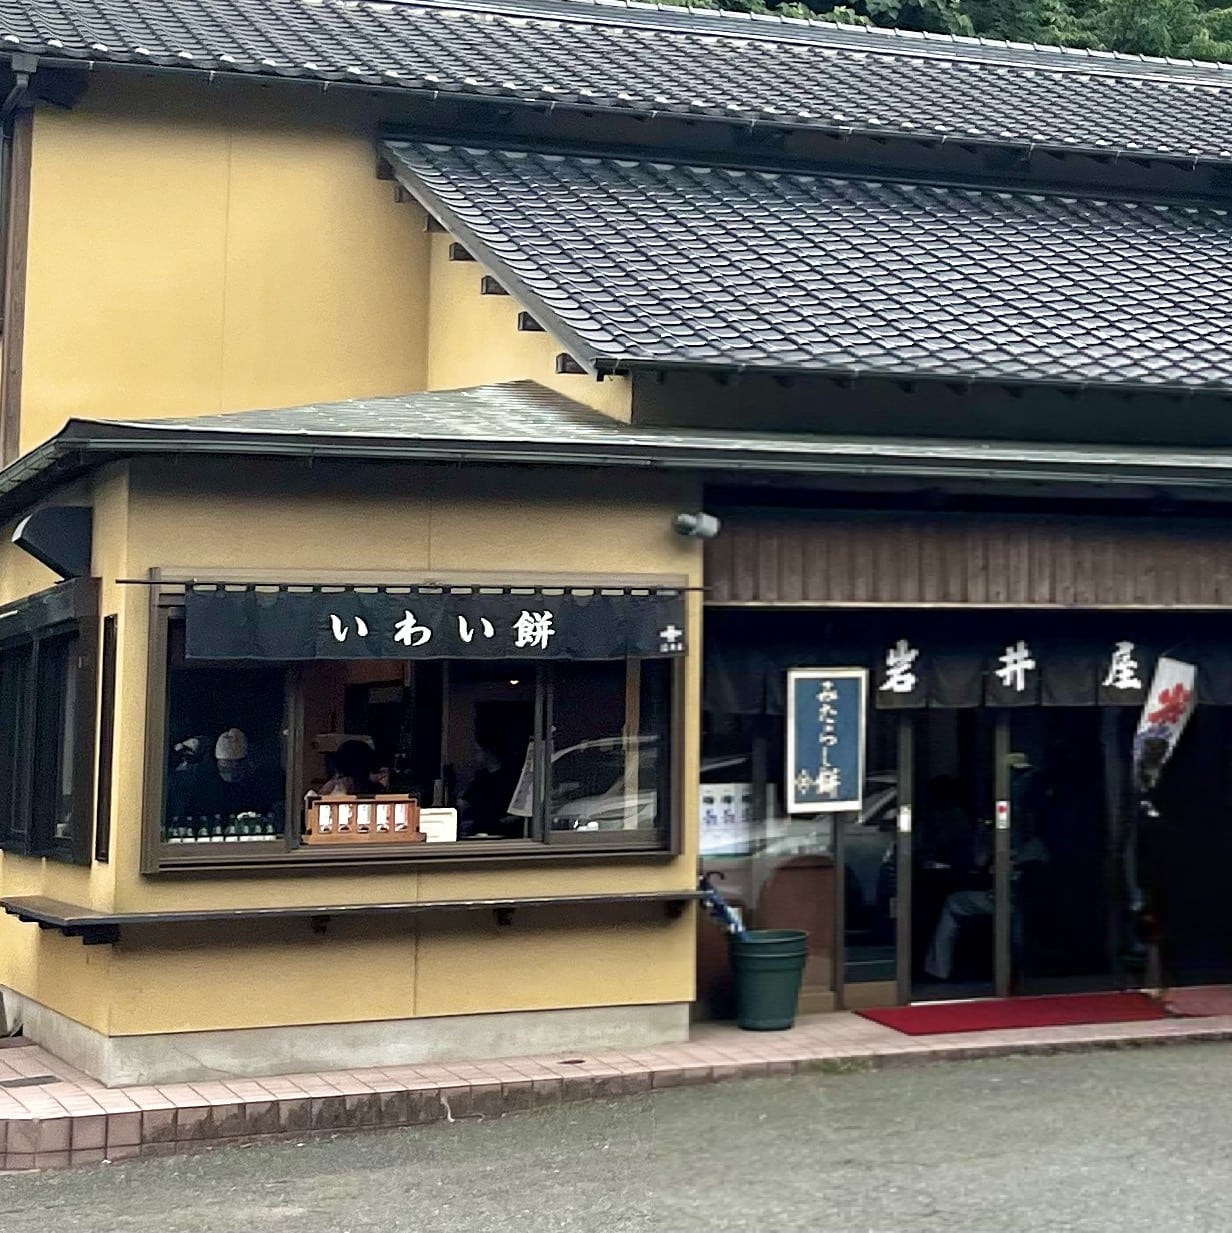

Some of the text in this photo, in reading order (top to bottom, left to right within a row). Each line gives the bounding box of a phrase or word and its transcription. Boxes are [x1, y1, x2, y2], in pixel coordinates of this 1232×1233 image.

[329, 610, 555, 650] いわい餅
[880, 640, 1142, 693] 岩井屋
